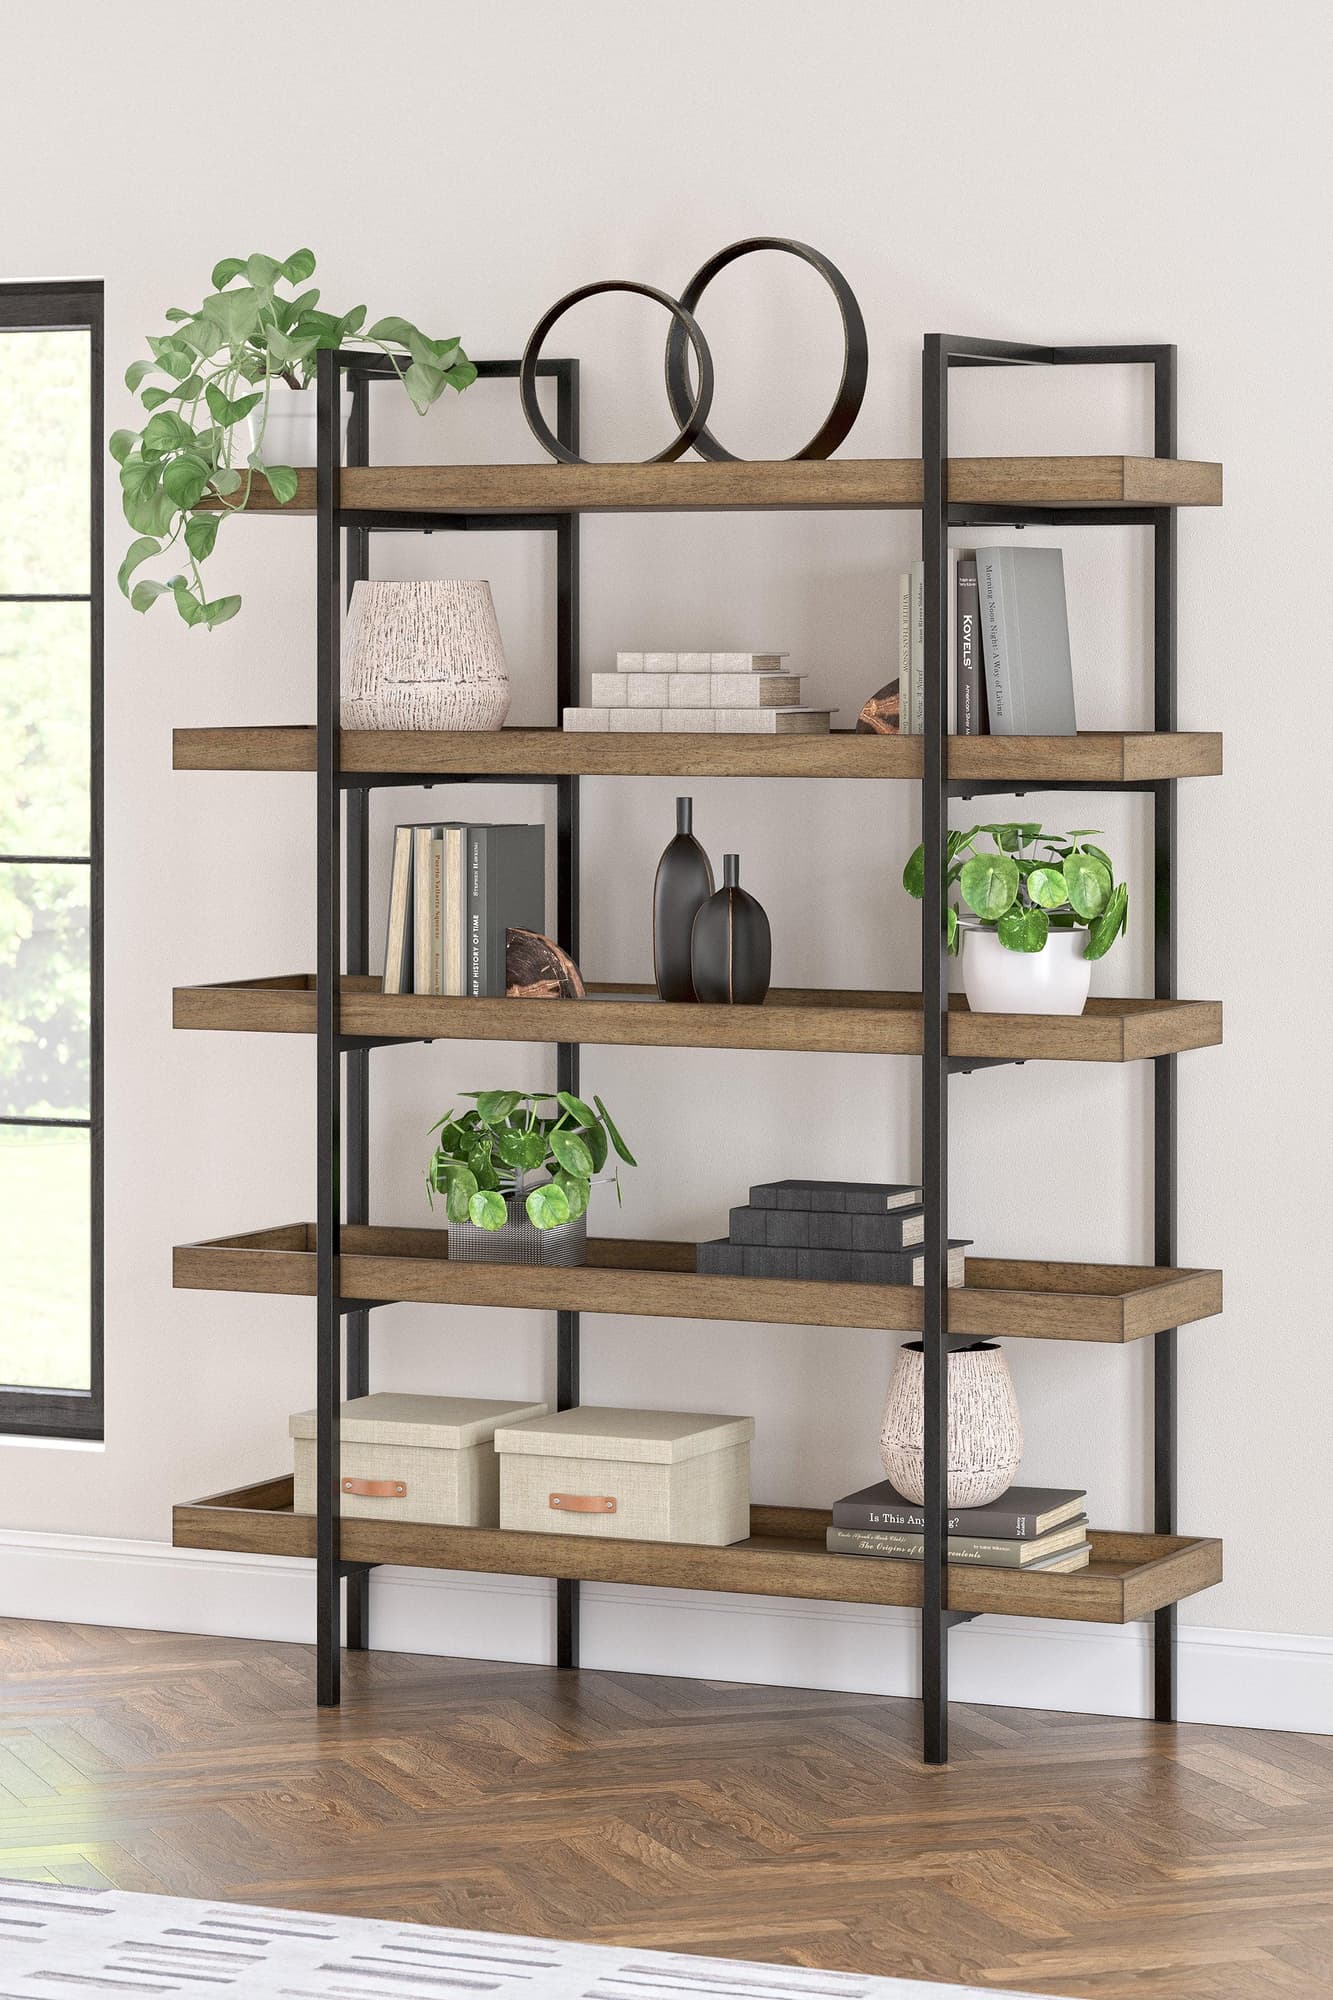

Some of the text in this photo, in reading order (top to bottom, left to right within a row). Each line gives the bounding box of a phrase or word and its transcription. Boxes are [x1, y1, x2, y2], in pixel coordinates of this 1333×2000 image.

[985, 565, 993, 600] Morning
[988, 602, 996, 623] Noon
[993, 661, 1001, 679] Way
[996, 691, 1004, 717] Living
[472, 934, 479, 944] OF
[869, 1512, 880, 1522] Is
[882, 1513, 905, 1524] This
[858, 1541, 875, 1550] The
[876, 1543, 905, 1554] Origins
[907, 1545, 917, 1556] of
